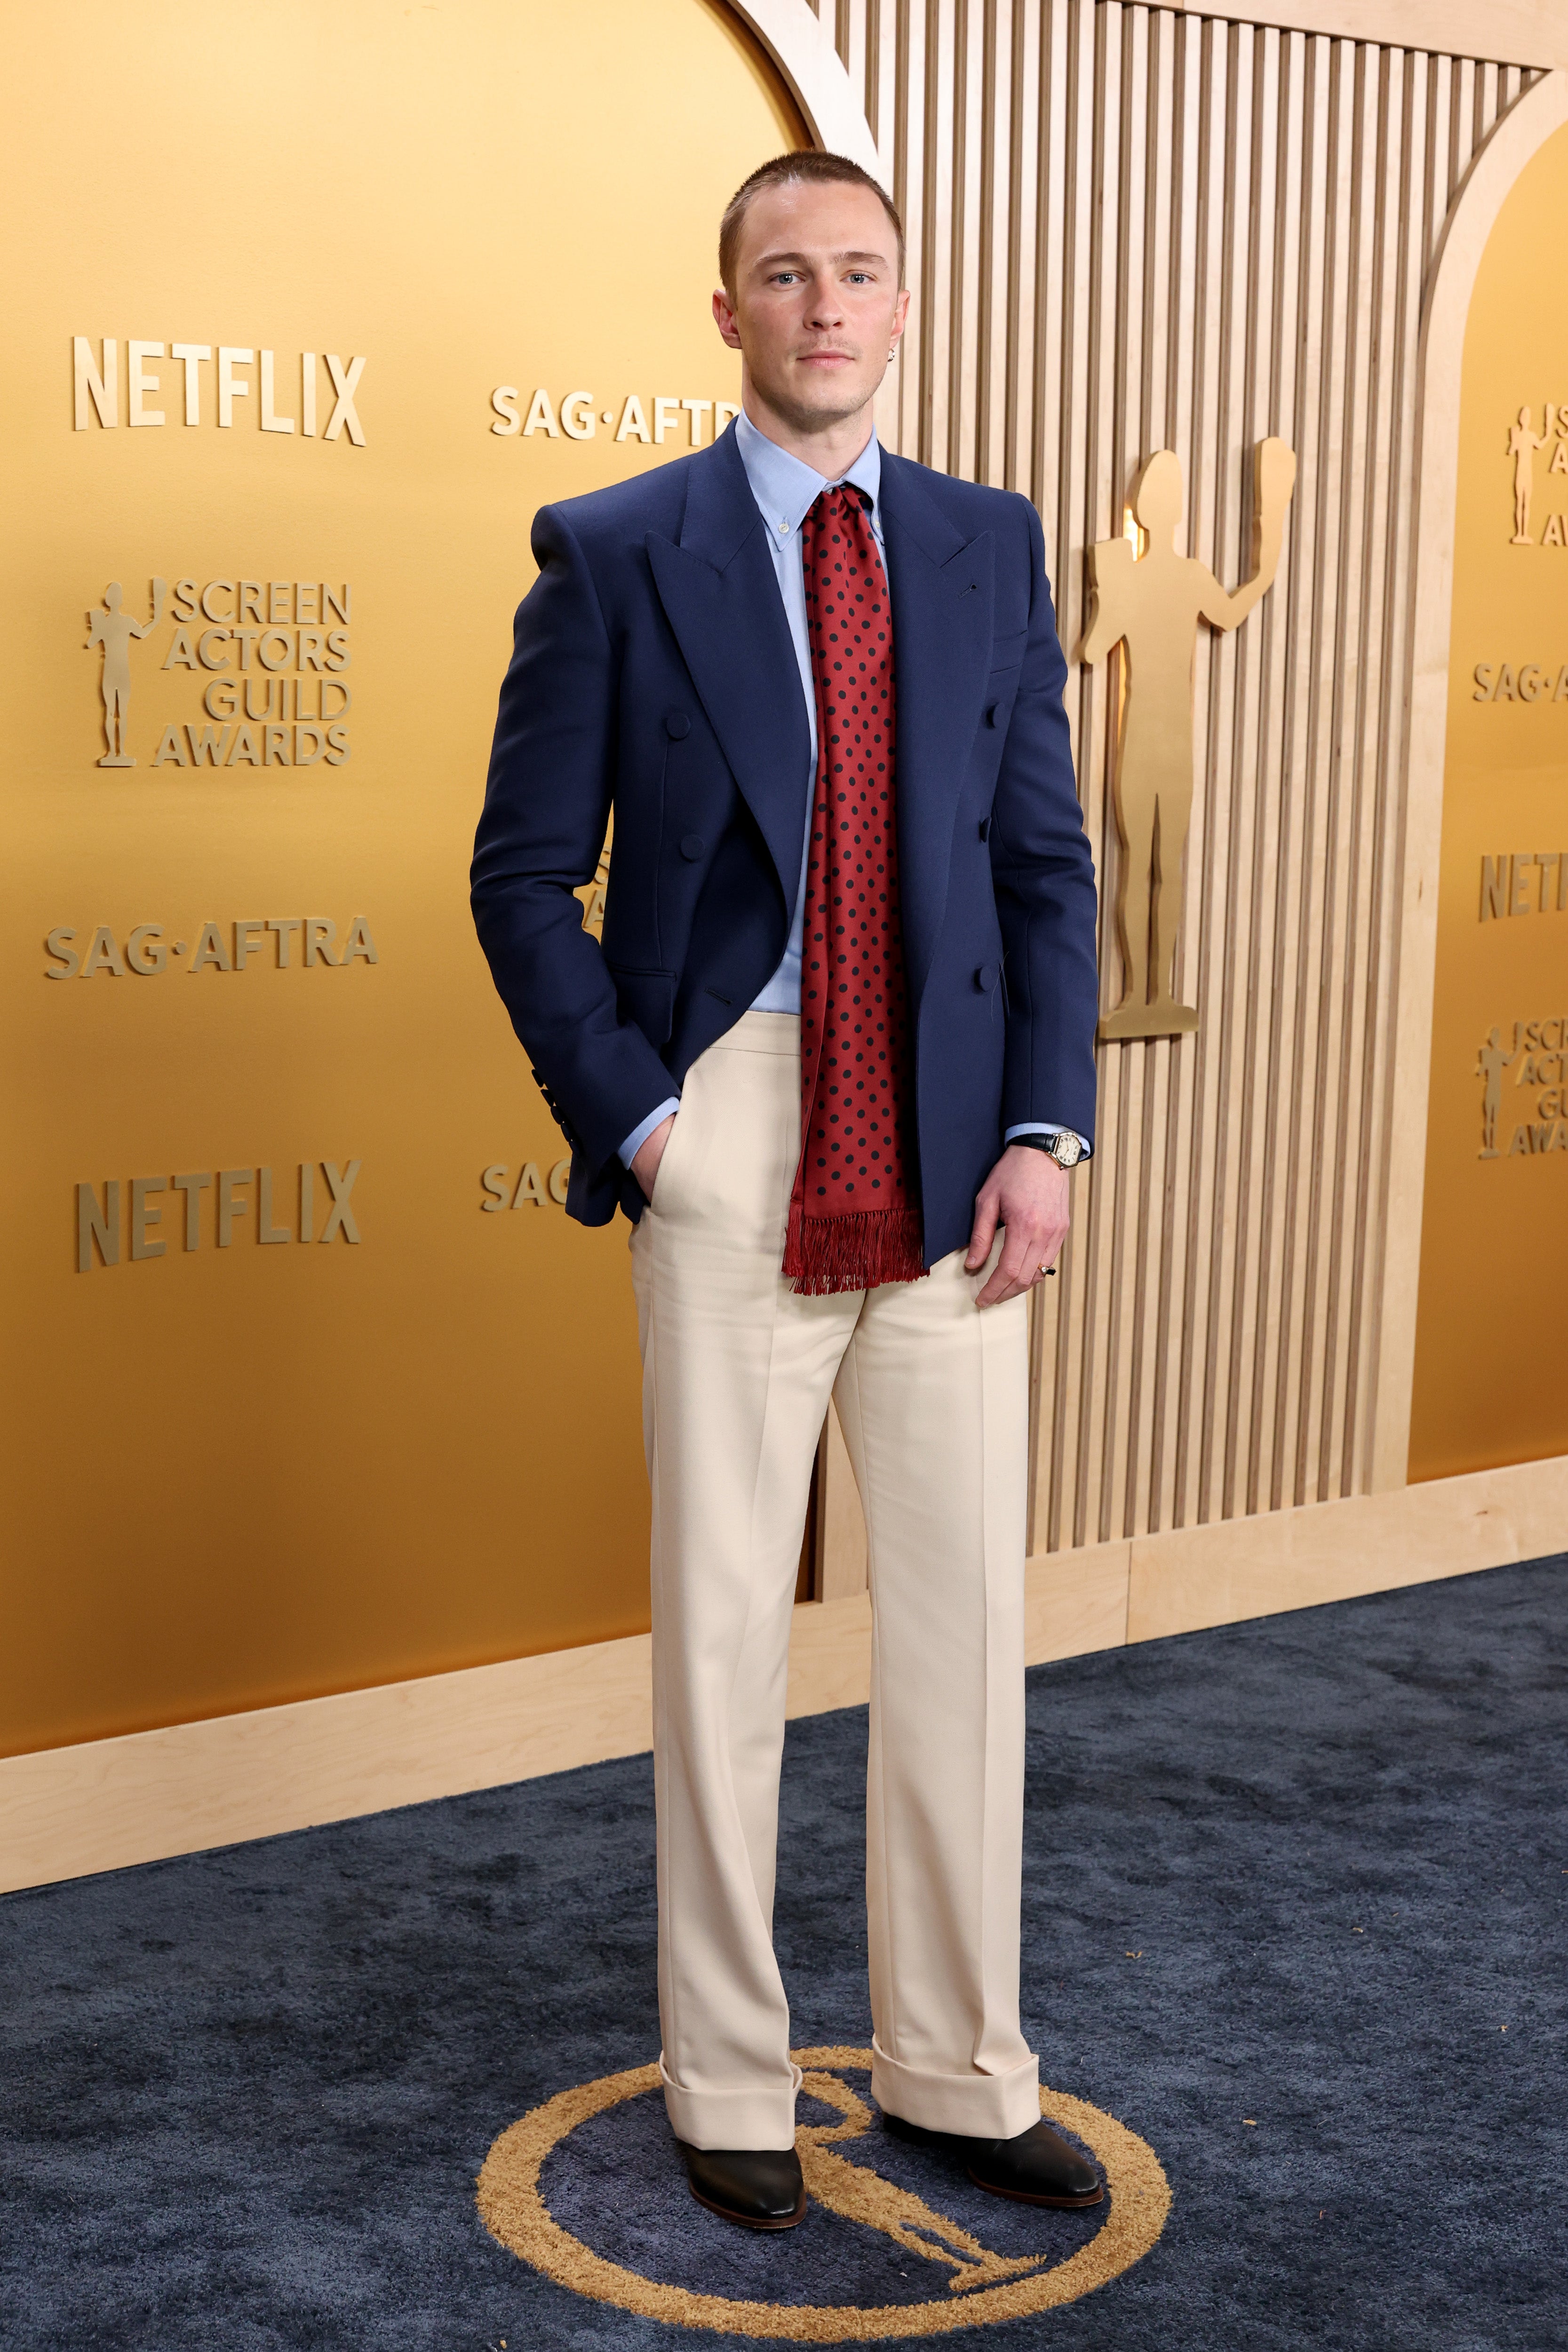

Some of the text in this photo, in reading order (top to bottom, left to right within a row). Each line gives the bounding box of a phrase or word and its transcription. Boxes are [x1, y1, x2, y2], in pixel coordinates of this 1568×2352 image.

[72, 336, 366, 447] NETFLIX
[171, 579, 351, 624] SCREEN
[161, 628, 351, 671] ACTORS
[204, 677, 352, 721] GUILD
[151, 724, 351, 767] AWARDS
[45, 915, 379, 980] SAG·AFTRA
[75, 1160, 362, 1273] NETFLIX
